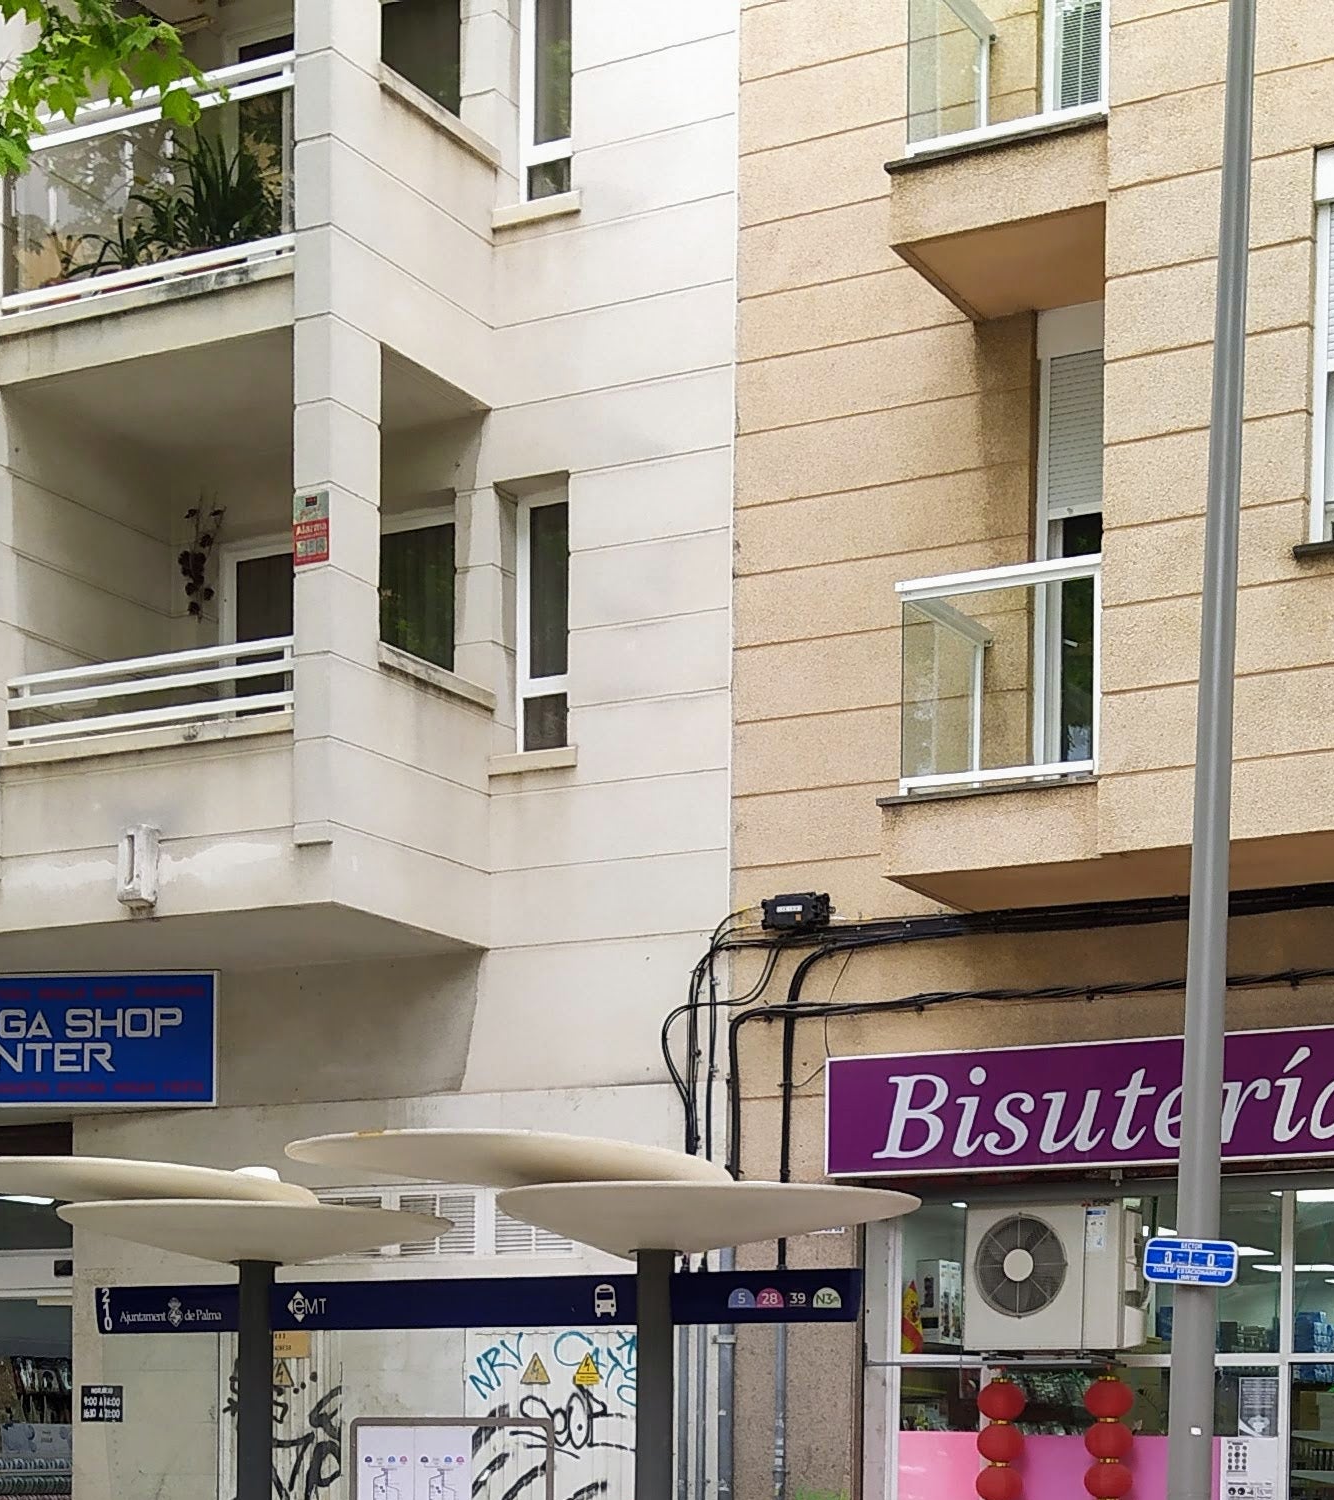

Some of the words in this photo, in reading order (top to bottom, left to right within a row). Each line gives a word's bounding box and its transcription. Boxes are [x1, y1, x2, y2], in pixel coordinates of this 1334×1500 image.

[295, 523, 327, 536] Alarma
[64, 1007, 183, 1039] SHOP
[737, 1292, 746, 1305] 5
[761, 1292, 778, 1305] 28
[789, 1292, 806, 1305] 39
[120, 1311, 167, 1325] Ajuntament
[184, 1310, 195, 1321] de
[196, 1310, 222, 1321] Palma
